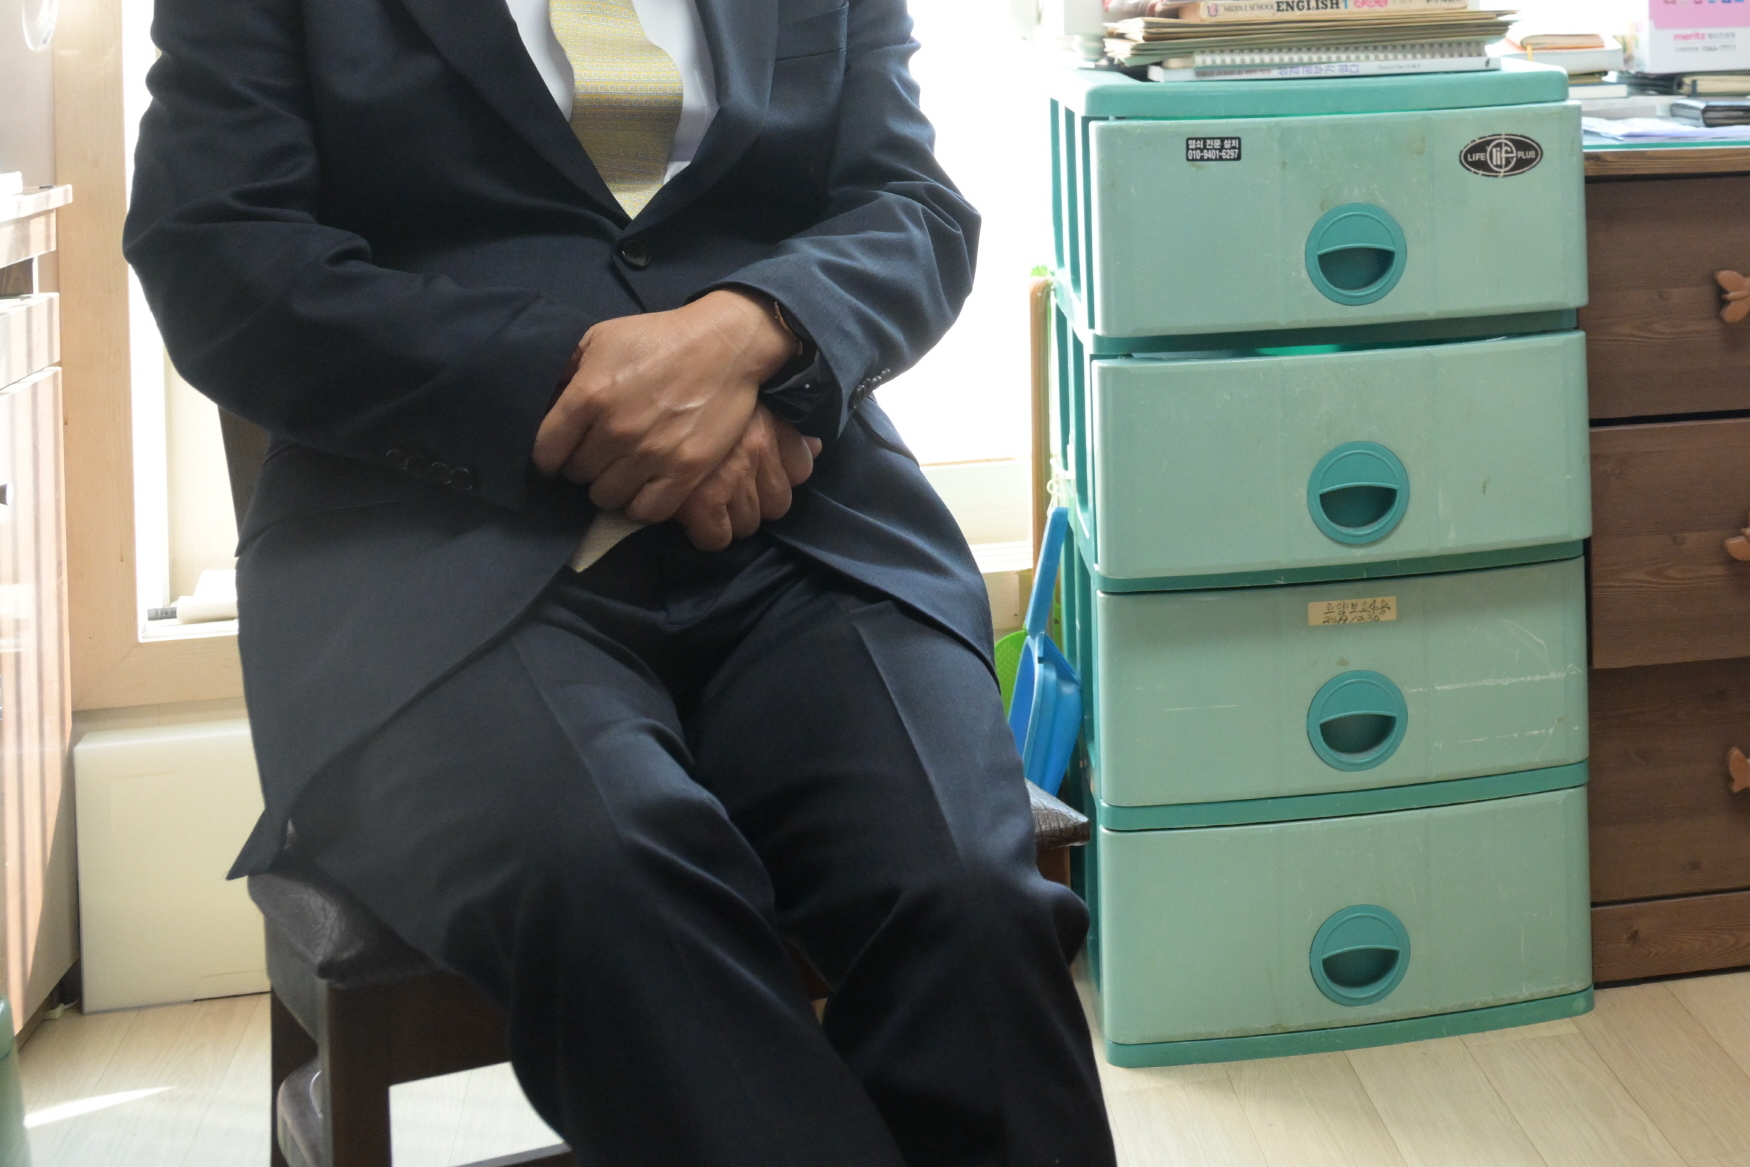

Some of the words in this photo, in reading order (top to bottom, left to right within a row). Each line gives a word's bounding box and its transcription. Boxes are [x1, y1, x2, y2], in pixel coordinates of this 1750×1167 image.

[1224, 4, 1247, 12] MIDDLE
[1275, 0, 1340, 12] ENGLISH
[1188, 139, 1204, 149] 열쇠
[1206, 139, 1221, 149] 전문
[1223, 138, 1239, 148] 설치
[1188, 149, 1239, 160] 010-9401-6297
[1467, 153, 1486, 161] LIFE
[1517, 150, 1536, 159] PLUS
